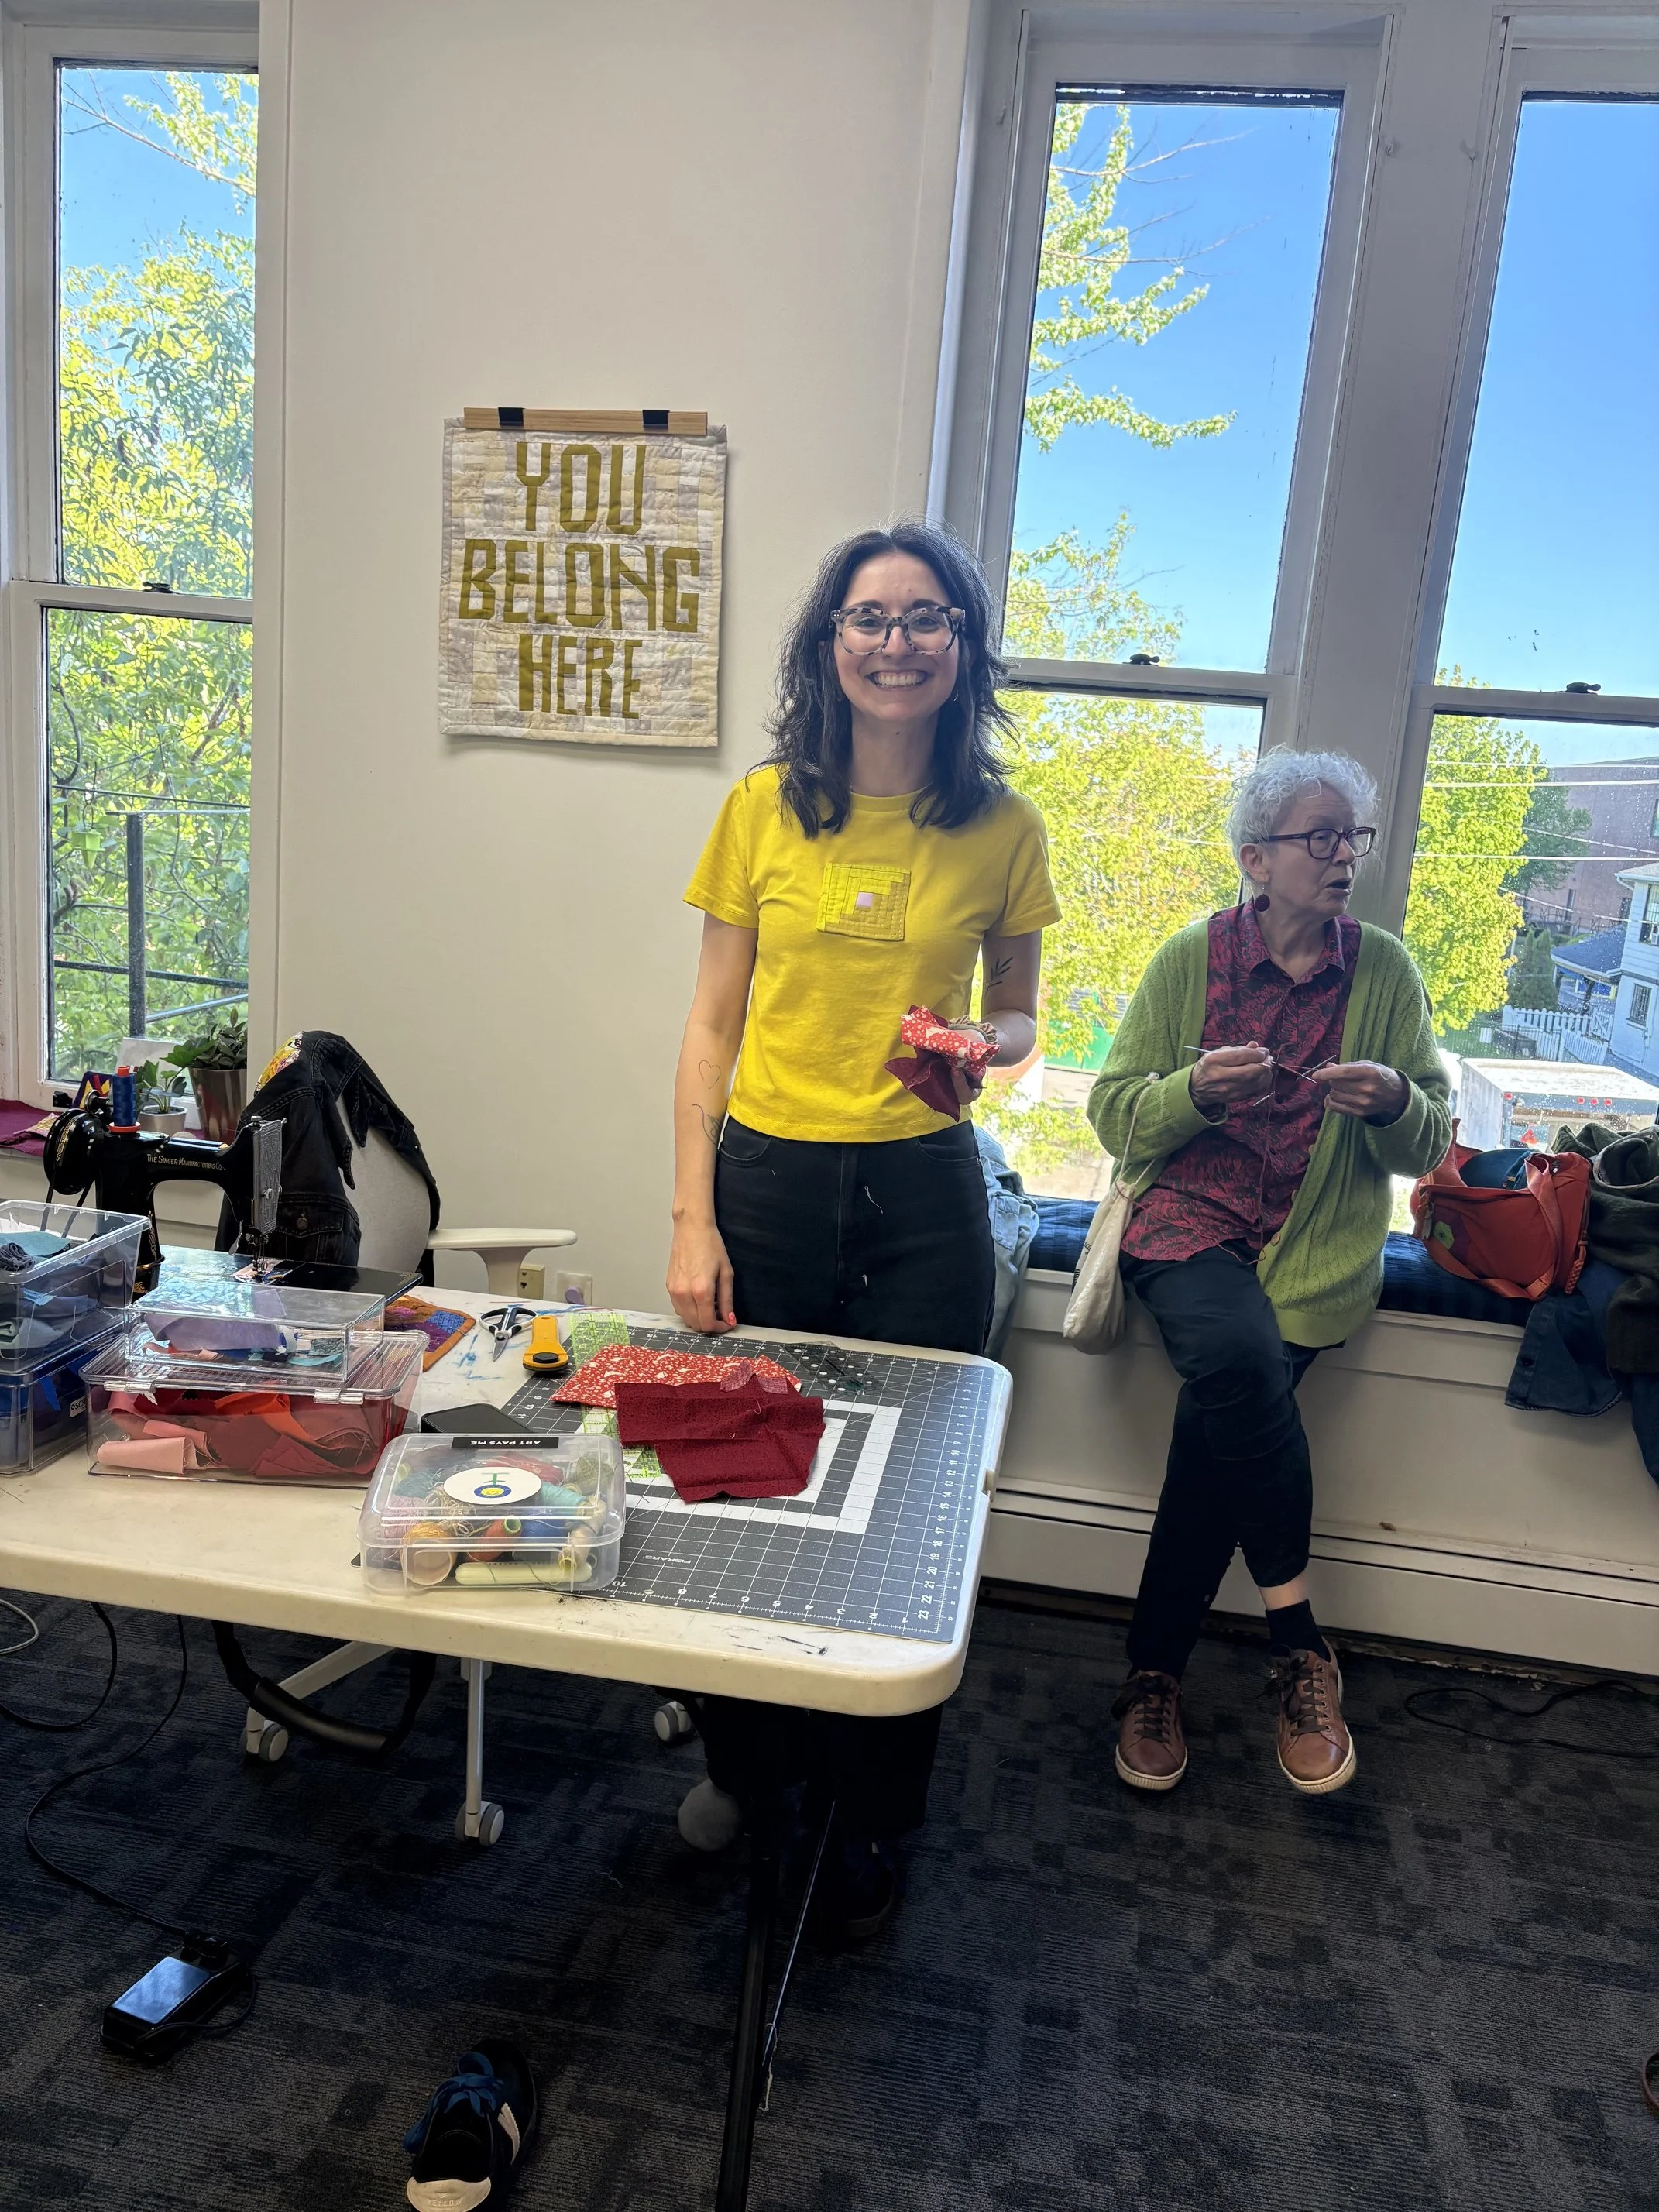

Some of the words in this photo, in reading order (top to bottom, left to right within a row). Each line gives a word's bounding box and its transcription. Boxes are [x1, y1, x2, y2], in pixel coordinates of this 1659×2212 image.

[516, 441, 647, 535] YOU
[459, 538, 700, 633] BELONG
[518, 633, 643, 719] HERE
[644, 1554, 692, 1565] FISKARS
[926, 1566, 938, 1575] 20
[924, 1580, 935, 1589] 21
[921, 1595, 933, 1604] 22
[918, 1610, 929, 1620] 23
